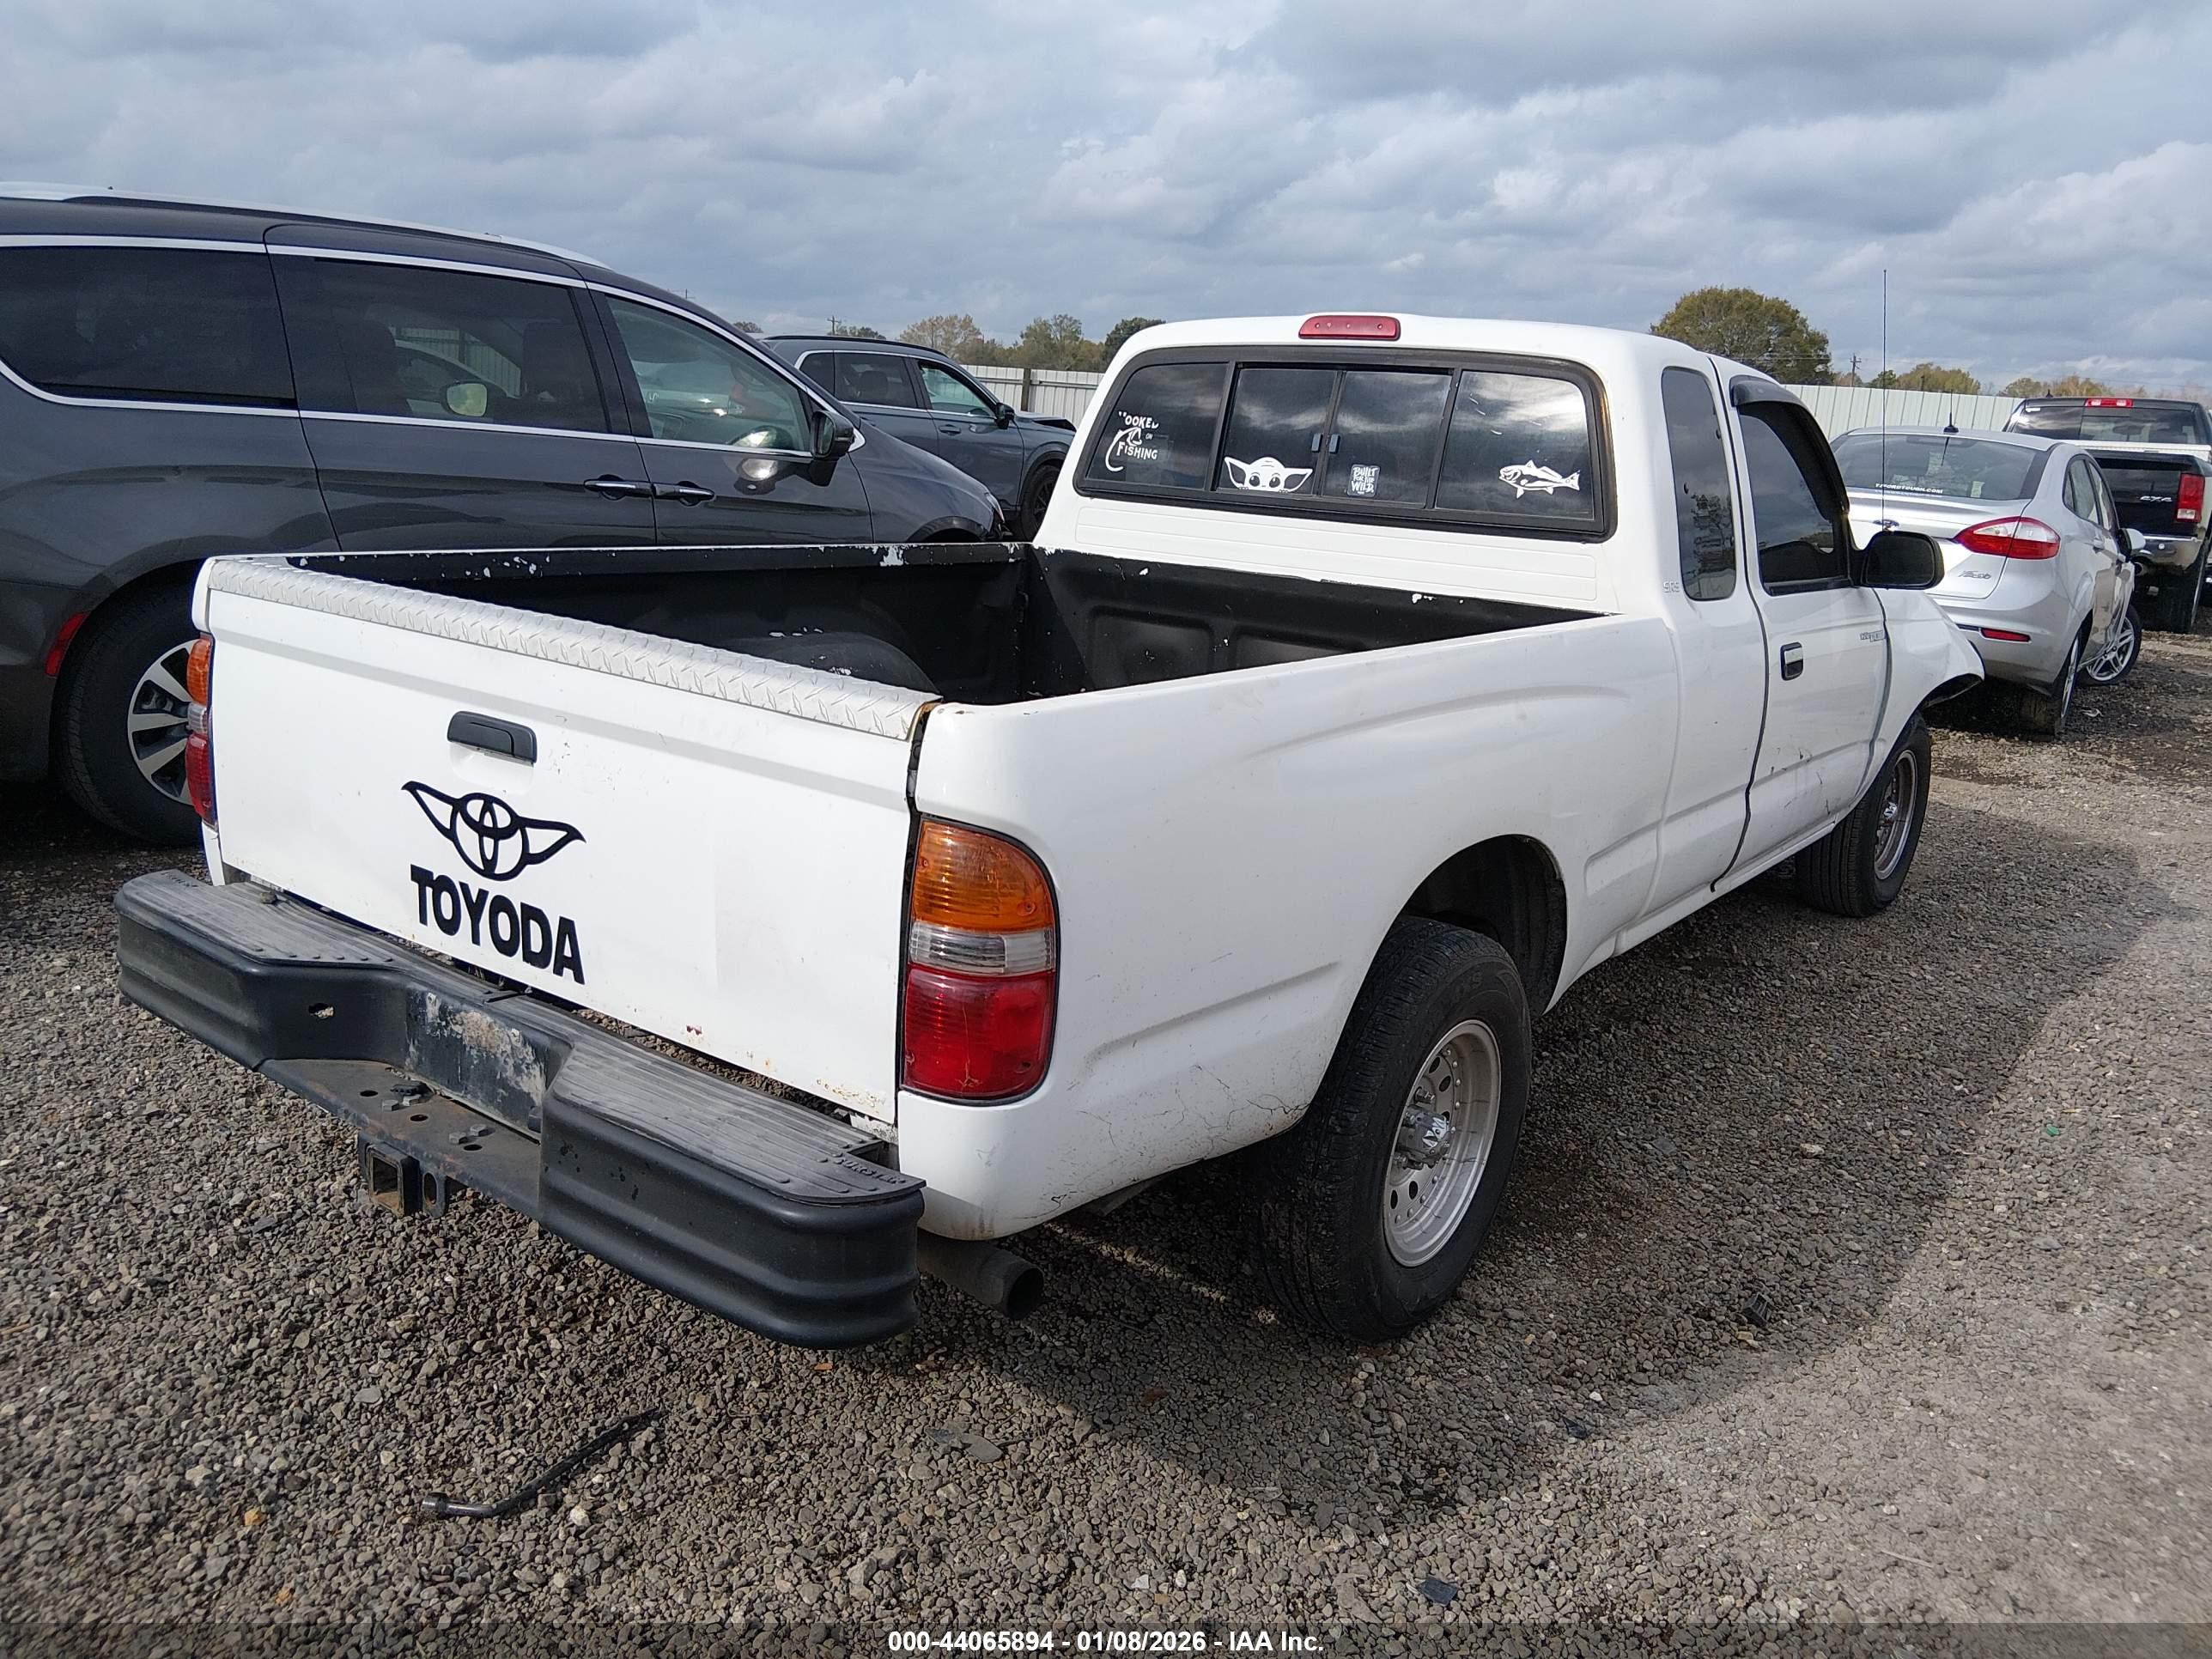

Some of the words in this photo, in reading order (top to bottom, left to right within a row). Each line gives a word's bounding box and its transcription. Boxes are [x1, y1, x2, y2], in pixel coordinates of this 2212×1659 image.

[1116, 441, 1158, 460] FISHING
[1352, 466, 1379, 477] BUILT
[410, 864, 586, 986] TOYODA
